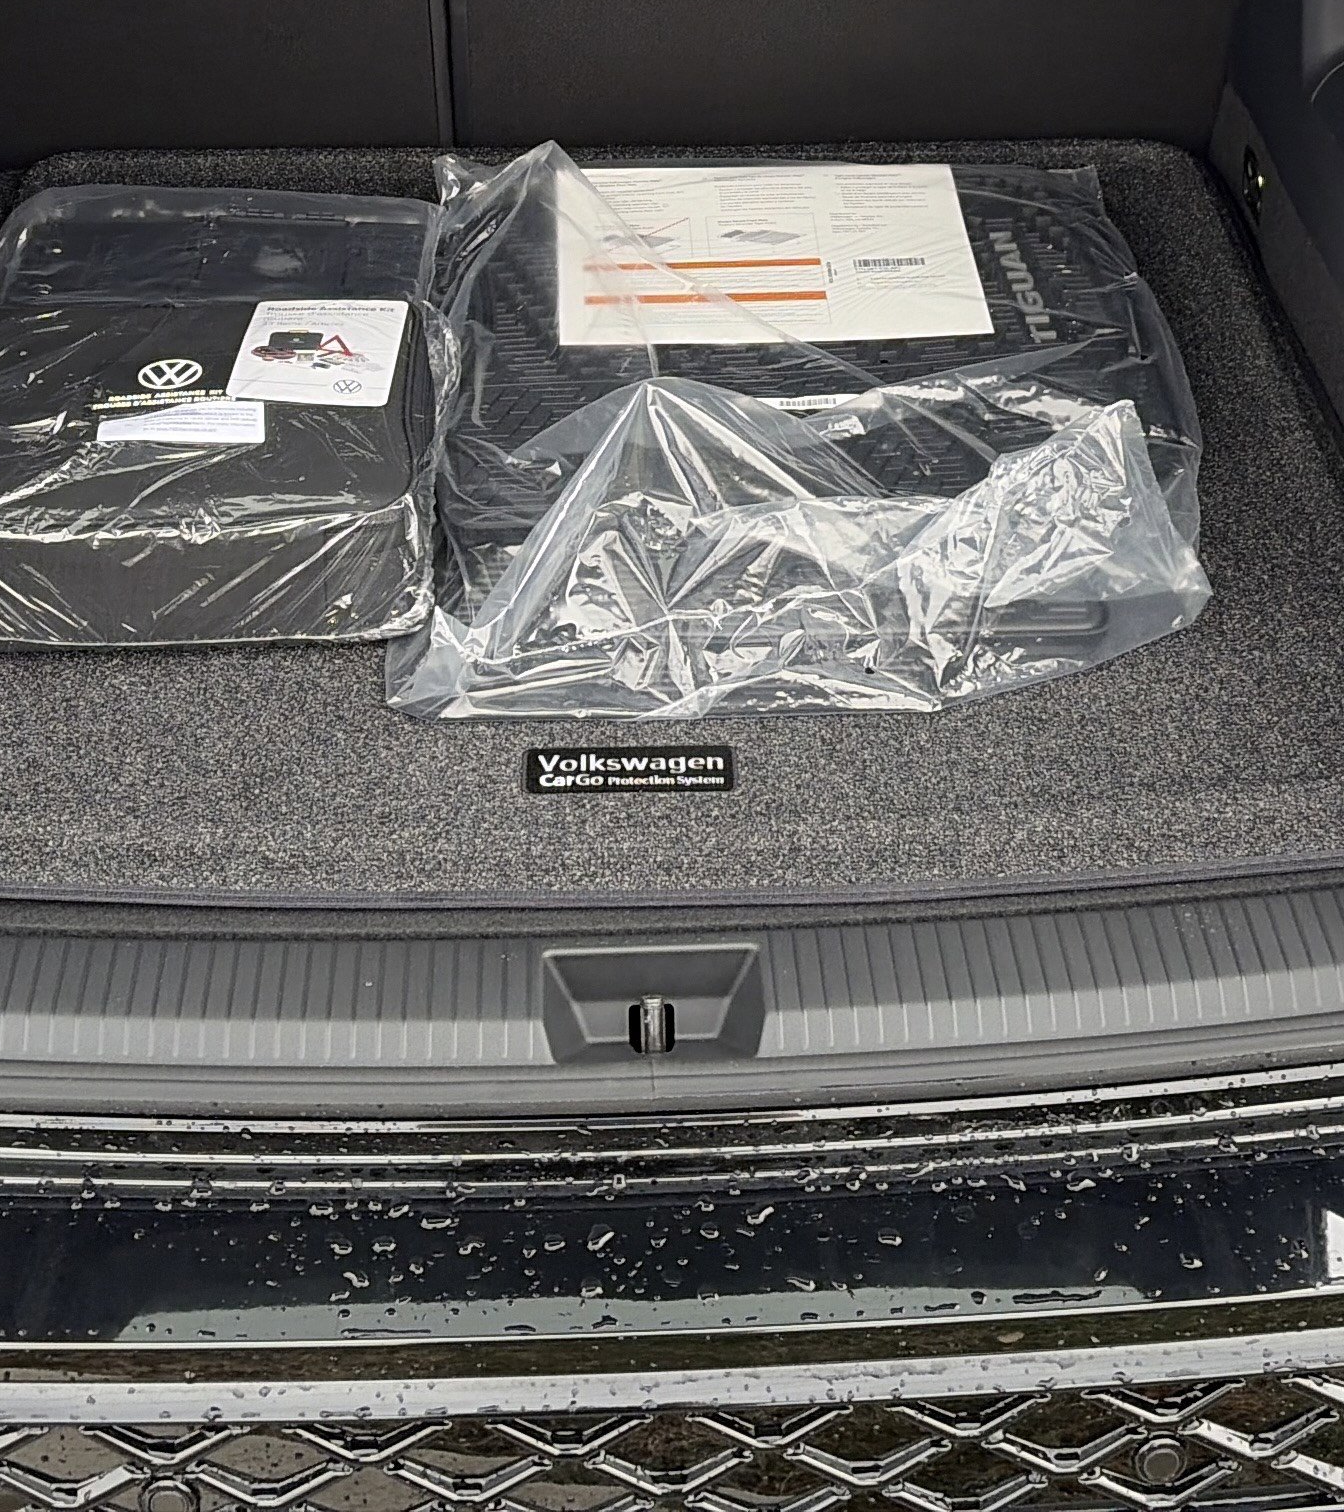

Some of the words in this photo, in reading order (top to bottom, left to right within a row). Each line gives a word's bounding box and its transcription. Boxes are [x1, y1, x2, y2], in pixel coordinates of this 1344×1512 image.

[989, 231, 1057, 344] TIGUAN
[538, 754, 724, 774] Volkswagen
[539, 773, 604, 787] CarGo
[607, 775, 675, 786] Protection
[677, 775, 725, 786] System
